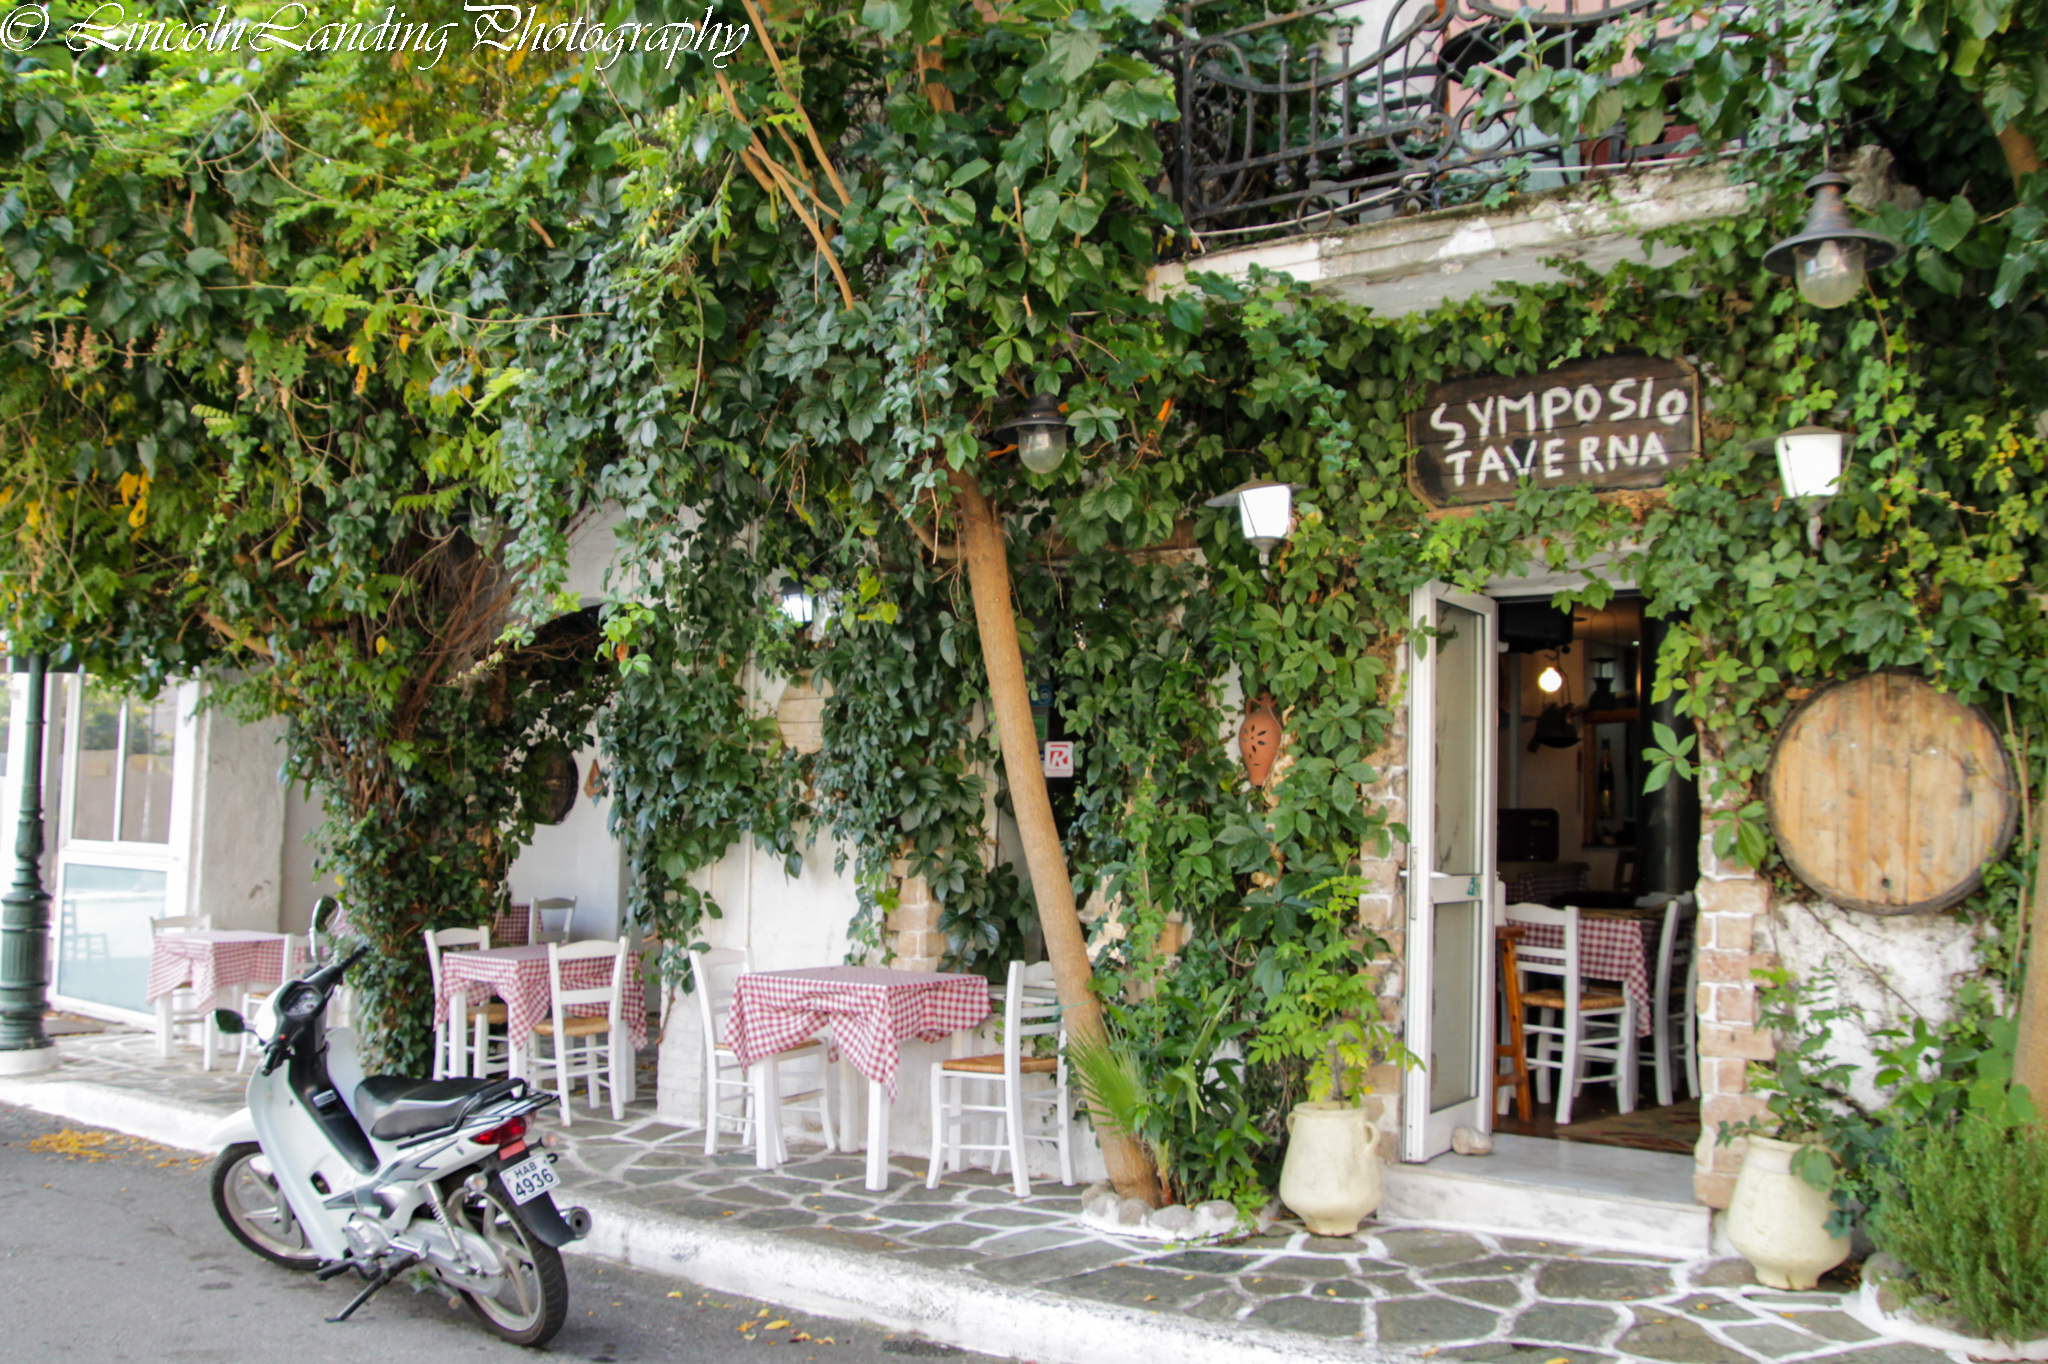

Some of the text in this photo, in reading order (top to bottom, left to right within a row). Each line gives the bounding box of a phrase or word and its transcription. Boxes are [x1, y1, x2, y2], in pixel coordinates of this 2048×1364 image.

[1429, 376, 1689, 450] SYMPOSIO
[1444, 430, 1670, 487] TAVERNA
[514, 1161, 537, 1178] HAB
[515, 1168, 554, 1197] 4936
